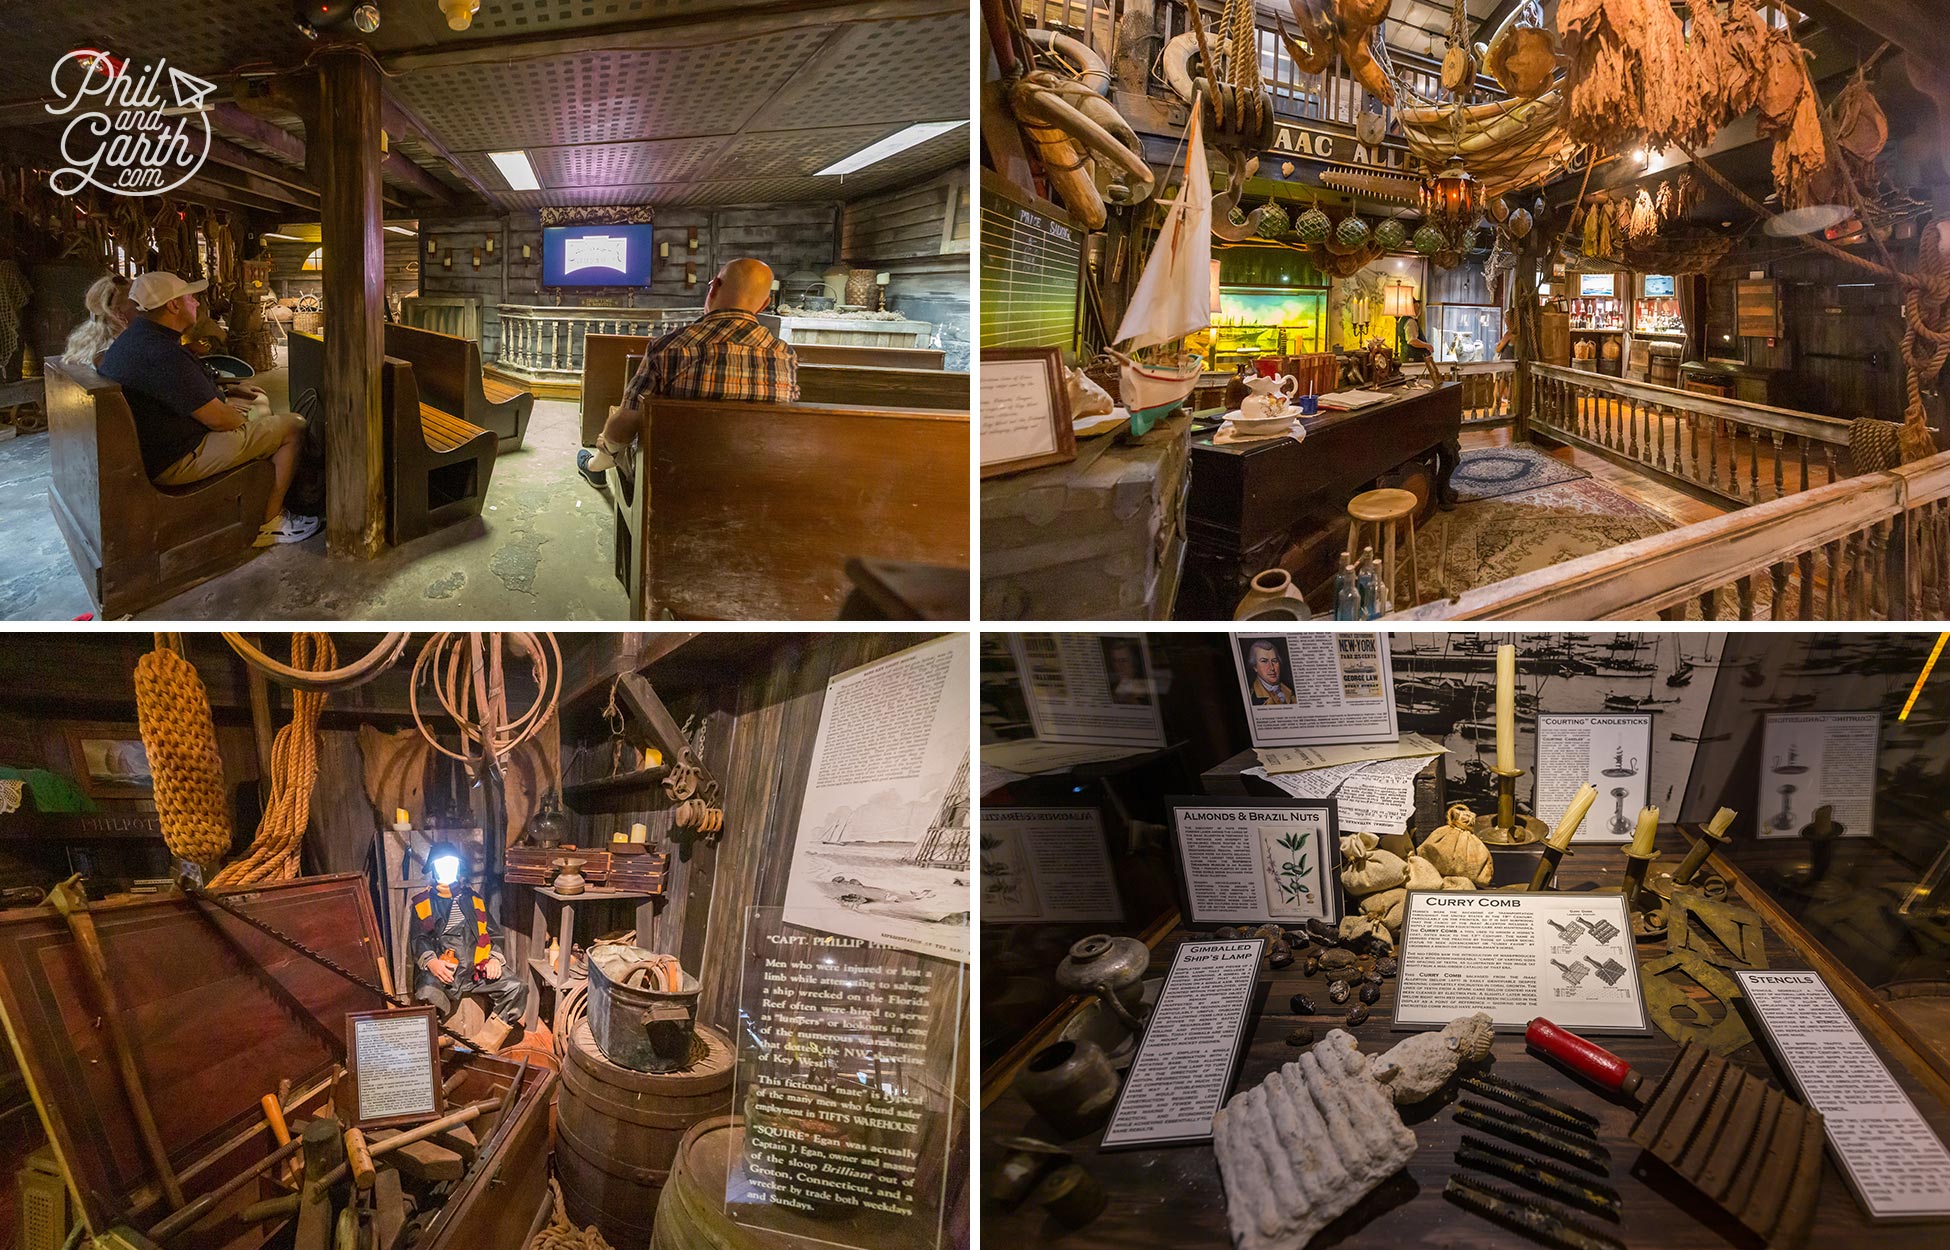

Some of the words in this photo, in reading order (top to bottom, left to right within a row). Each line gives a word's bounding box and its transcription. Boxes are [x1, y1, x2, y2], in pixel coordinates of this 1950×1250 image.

[1274, 128, 1333, 157] AAC
[1352, 145, 1421, 172] ALLE
[81, 818, 160, 831] PHILPOT
[1184, 812, 1235, 821] ALMONDS
[1238, 813, 1247, 821] &
[1249, 813, 1288, 821] BRAZIL
[1291, 813, 1319, 822] NUTS
[1426, 897, 1475, 907] CURRY
[1478, 898, 1521, 908] COMB
[813, 937, 864, 948] PHILLIP
[1191, 945, 1251, 953] GIMBALLED
[766, 958, 787, 967] Men
[792, 961, 812, 970] who
[816, 964, 840, 972] were
[844, 965, 881, 975] injured
[902, 967, 921, 977] lost
[764, 972, 787, 982] limb
[790, 974, 817, 984] while
[879, 981, 889, 989] to
[1749, 976, 1814, 984] STENCILS
[773, 987, 794, 997] ship
[799, 989, 843, 1000] wrecked
[866, 994, 884, 1004] the
[888, 995, 929, 1007] Florida
[763, 999, 787, 1009] Reef
[790, 1002, 816, 1012] often
[821, 1005, 845, 1014] were
[850, 1006, 880, 1018] hired
[884, 1010, 896, 1019] to
[900, 1013, 929, 1021] serve
[760, 1027, 771, 1035] of
[776, 1027, 793, 1037] the
[798, 1031, 853, 1043] numerous
[775, 1014, 824, 1027] "lumpers"
[843, 1020, 888, 1033] lookouts
[892, 1025, 903, 1034] in
[907, 1027, 927, 1036] one
[761, 1040, 780, 1050] that
[822, 1046, 840, 1056] the
[758, 1053, 769, 1061] of
[773, 1055, 794, 1066] Key
[758, 1075, 781, 1086] This
[785, 1079, 827, 1092] fictional
[831, 1085, 867, 1097] "mate"
[871, 1090, 880, 1098] is
[756, 1089, 766, 1097] of
[769, 1090, 784, 1100] the
[787, 1094, 814, 1105] many
[816, 1098, 837, 1107] men
[841, 1101, 862, 1111] who
[865, 1103, 894, 1116] found
[897, 1109, 922, 1119] safer
[755, 1103, 803, 1117] employment
[806, 1109, 815, 1118] in
[853, 1116, 918, 1134] WAREHOUSE
[753, 1124, 809, 1141] "SQUIRE"
[813, 1134, 841, 1147] Egan
[845, 1140, 866, 1151] was
[871, 1144, 918, 1160] actually
[752, 1138, 787, 1151] Captain
[790, 1144, 797, 1153] J.
[801, 1146, 827, 1159] Egan,
[829, 1152, 858, 1164] owner
[861, 1157, 879, 1167] and
[883, 1161, 916, 1173] master
[751, 1152, 763, 1160] of
[766, 1154, 784, 1165] the
[789, 1158, 818, 1171] sloop
[822, 1164, 874, 1180] Brilliant
[878, 1173, 897, 1185] out
[902, 1178, 916, 1187] of
[750, 1164, 793, 1180] Groton,
[797, 1173, 873, 1195] Connecticut,
[876, 1188, 901, 1199] and
[906, 1194, 913, 1202] a
[747, 1190, 766, 1201] and
[769, 1194, 815, 1211] Sundays.
[749, 1178, 787, 1192] wrecker
[790, 1184, 802, 1196] by
[805, 1189, 832, 1201] trade
[835, 1193, 859, 1206] both
[863, 1200, 913, 1216] weekdays
